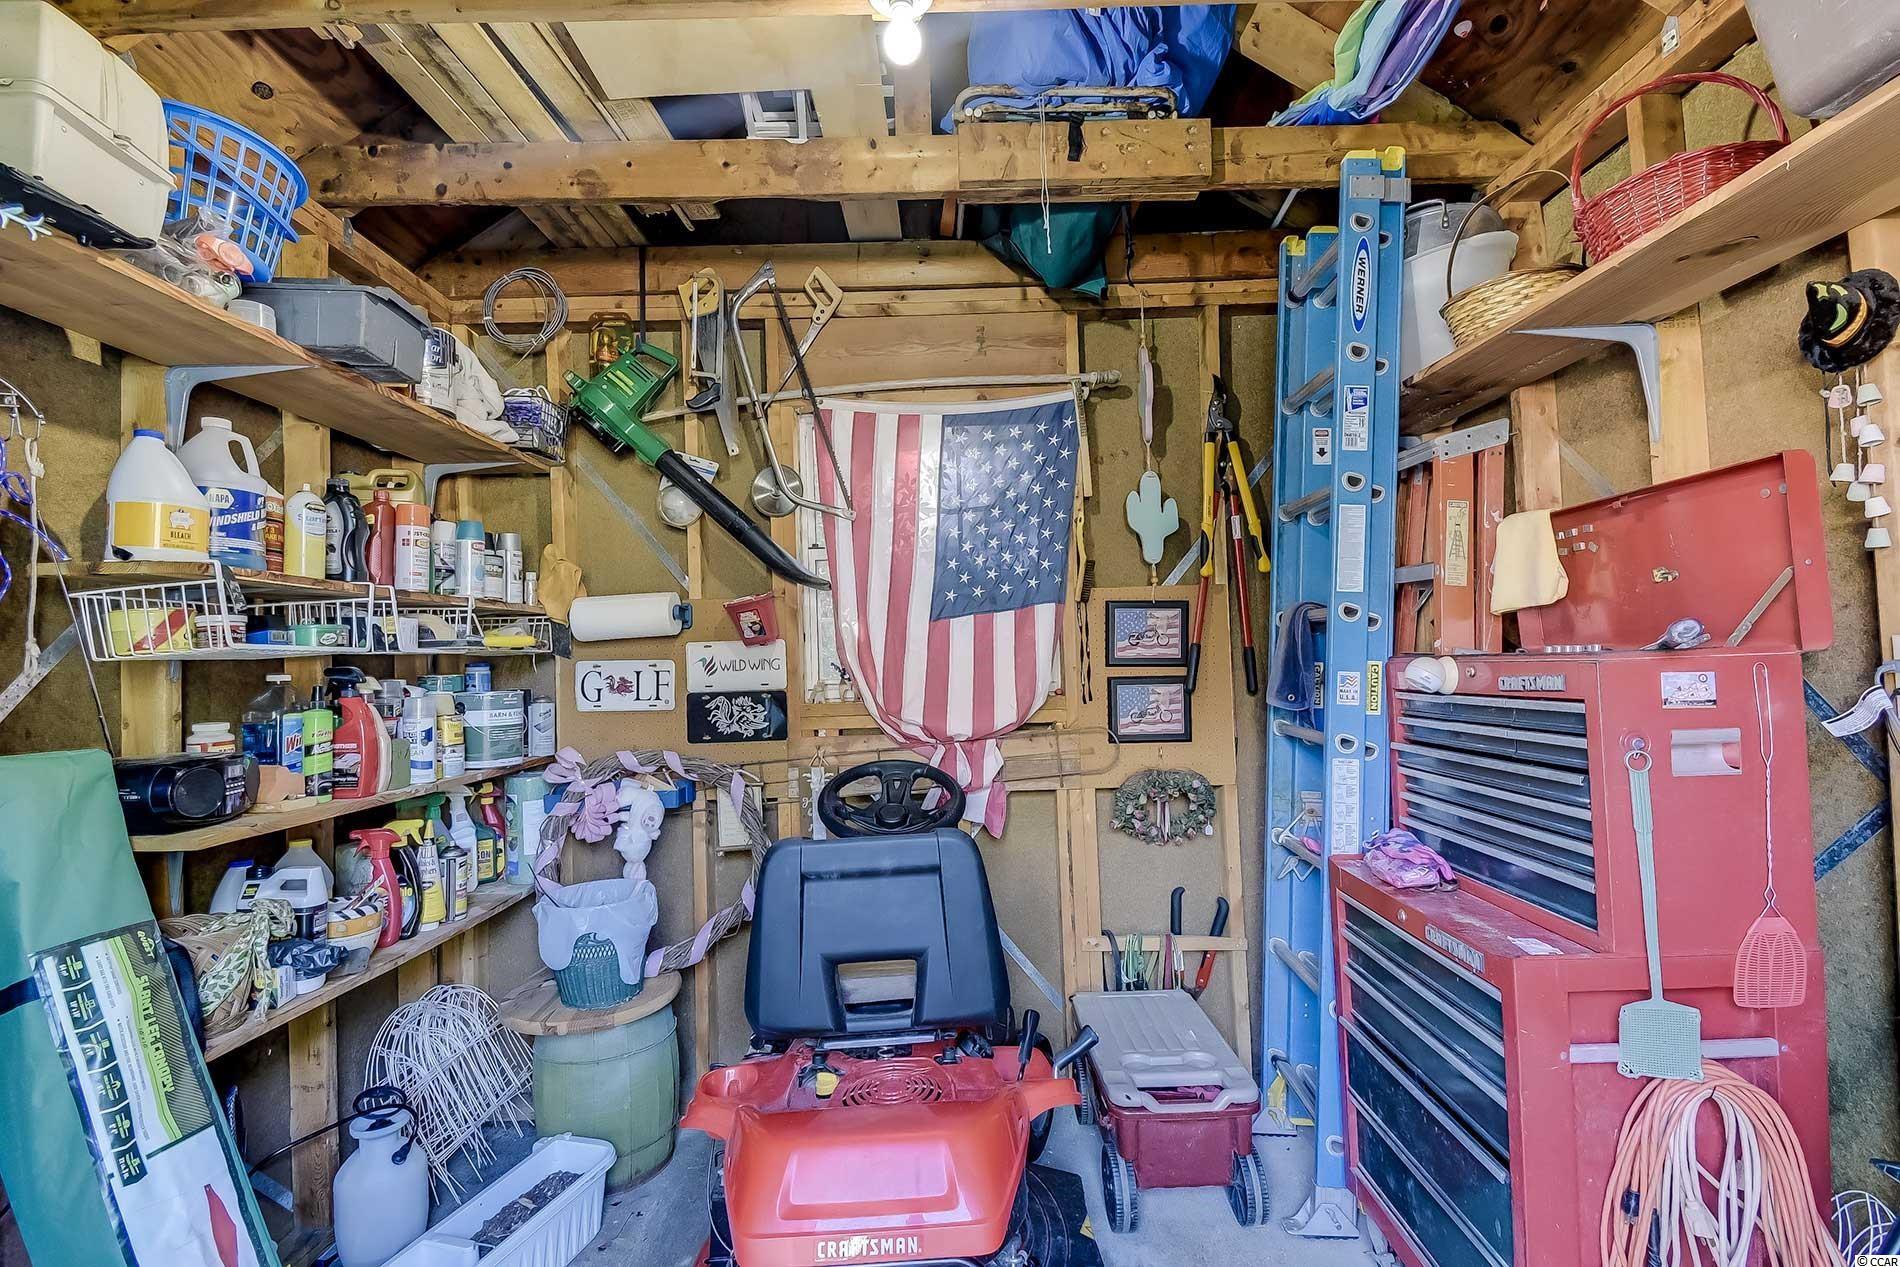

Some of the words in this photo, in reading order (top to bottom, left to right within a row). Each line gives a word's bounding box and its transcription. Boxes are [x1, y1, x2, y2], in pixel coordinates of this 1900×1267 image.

[1355, 256, 1367, 314] WERNER
[170, 530, 192, 540] BLEACH
[719, 657, 747, 672] WILD
[749, 657, 781, 672] WING
[581, 669, 671, 703] GLF
[1370, 664, 1380, 711] CAUTION
[136, 930, 155, 958] QUEST
[136, 975, 154, 1016] SLANT
[146, 1018, 161, 1042] LEG
[152, 1042, 175, 1092] CANOPY
